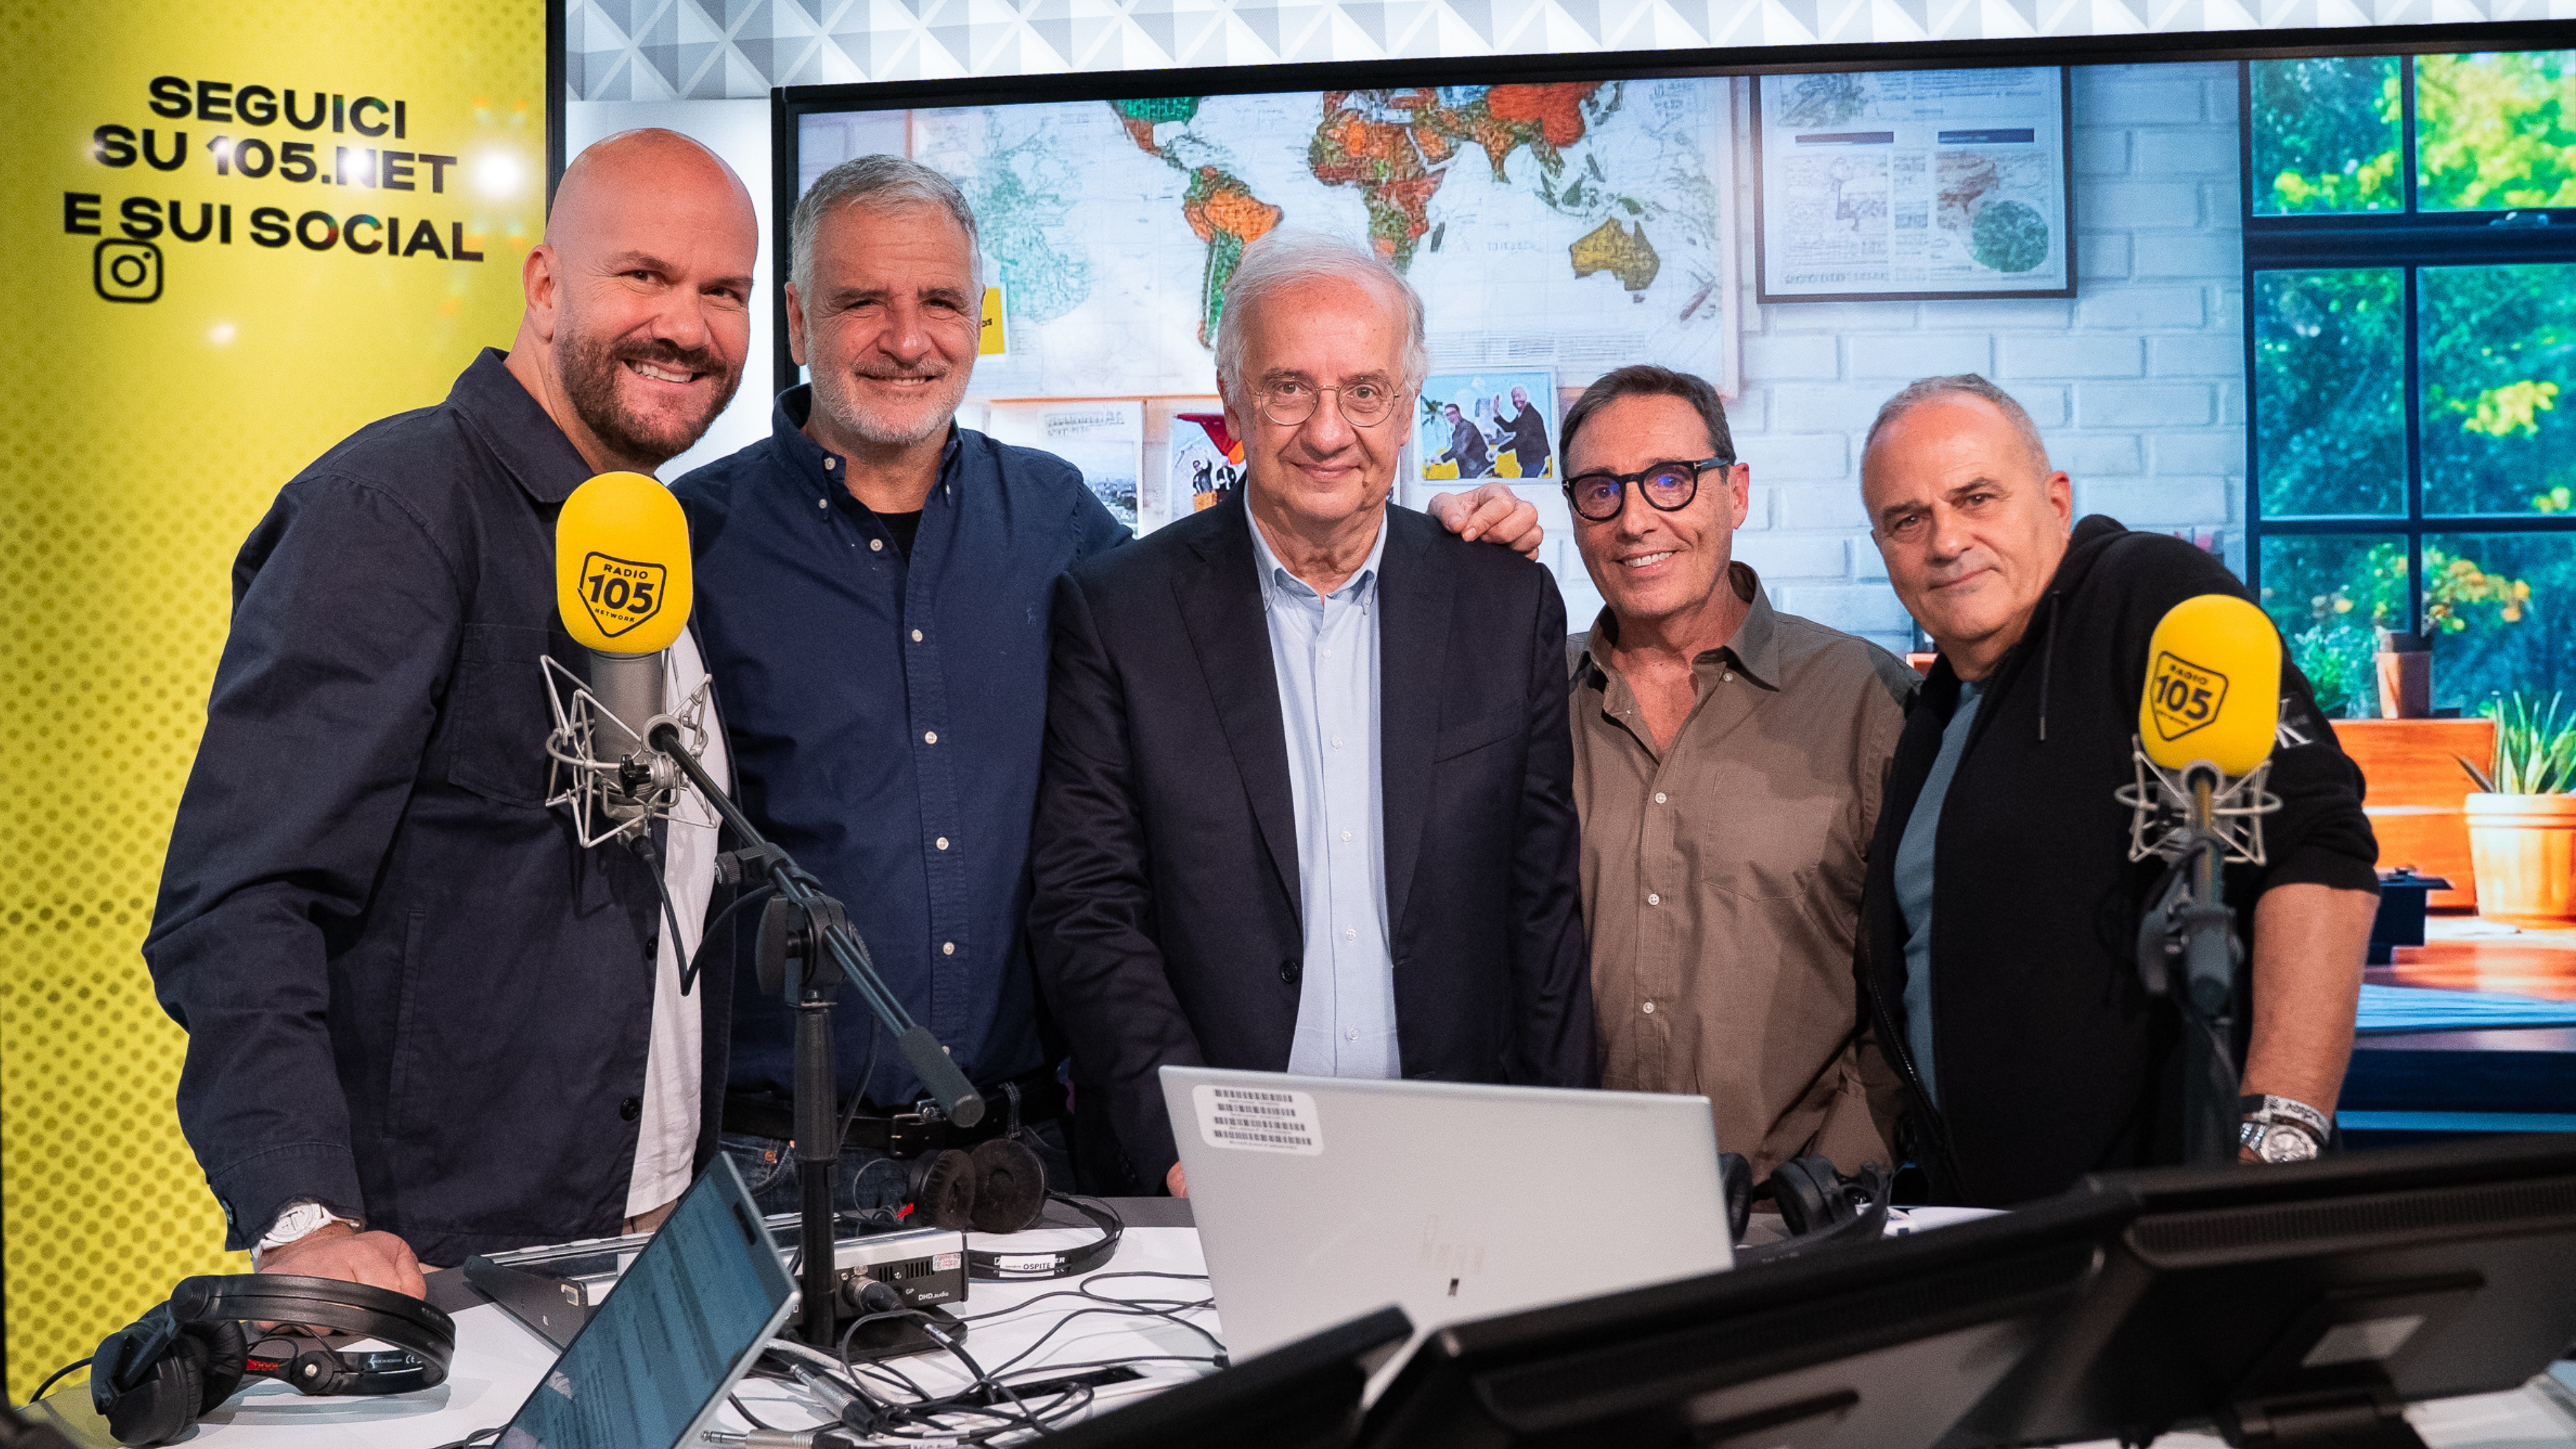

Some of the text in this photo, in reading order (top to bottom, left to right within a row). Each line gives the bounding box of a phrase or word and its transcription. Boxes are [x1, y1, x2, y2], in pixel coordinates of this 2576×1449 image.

[148, 75, 407, 140] SEGUICI
[93, 124, 458, 195] SU 105.NET
[63, 191, 484, 262] E SUI SOCIAL
[604, 564, 649, 579] RADIO
[588, 574, 655, 614] 105
[594, 608, 636, 623] NETWORK
[2156, 674, 2212, 720] 105
[918, 1290, 950, 1301] DHD.audio
